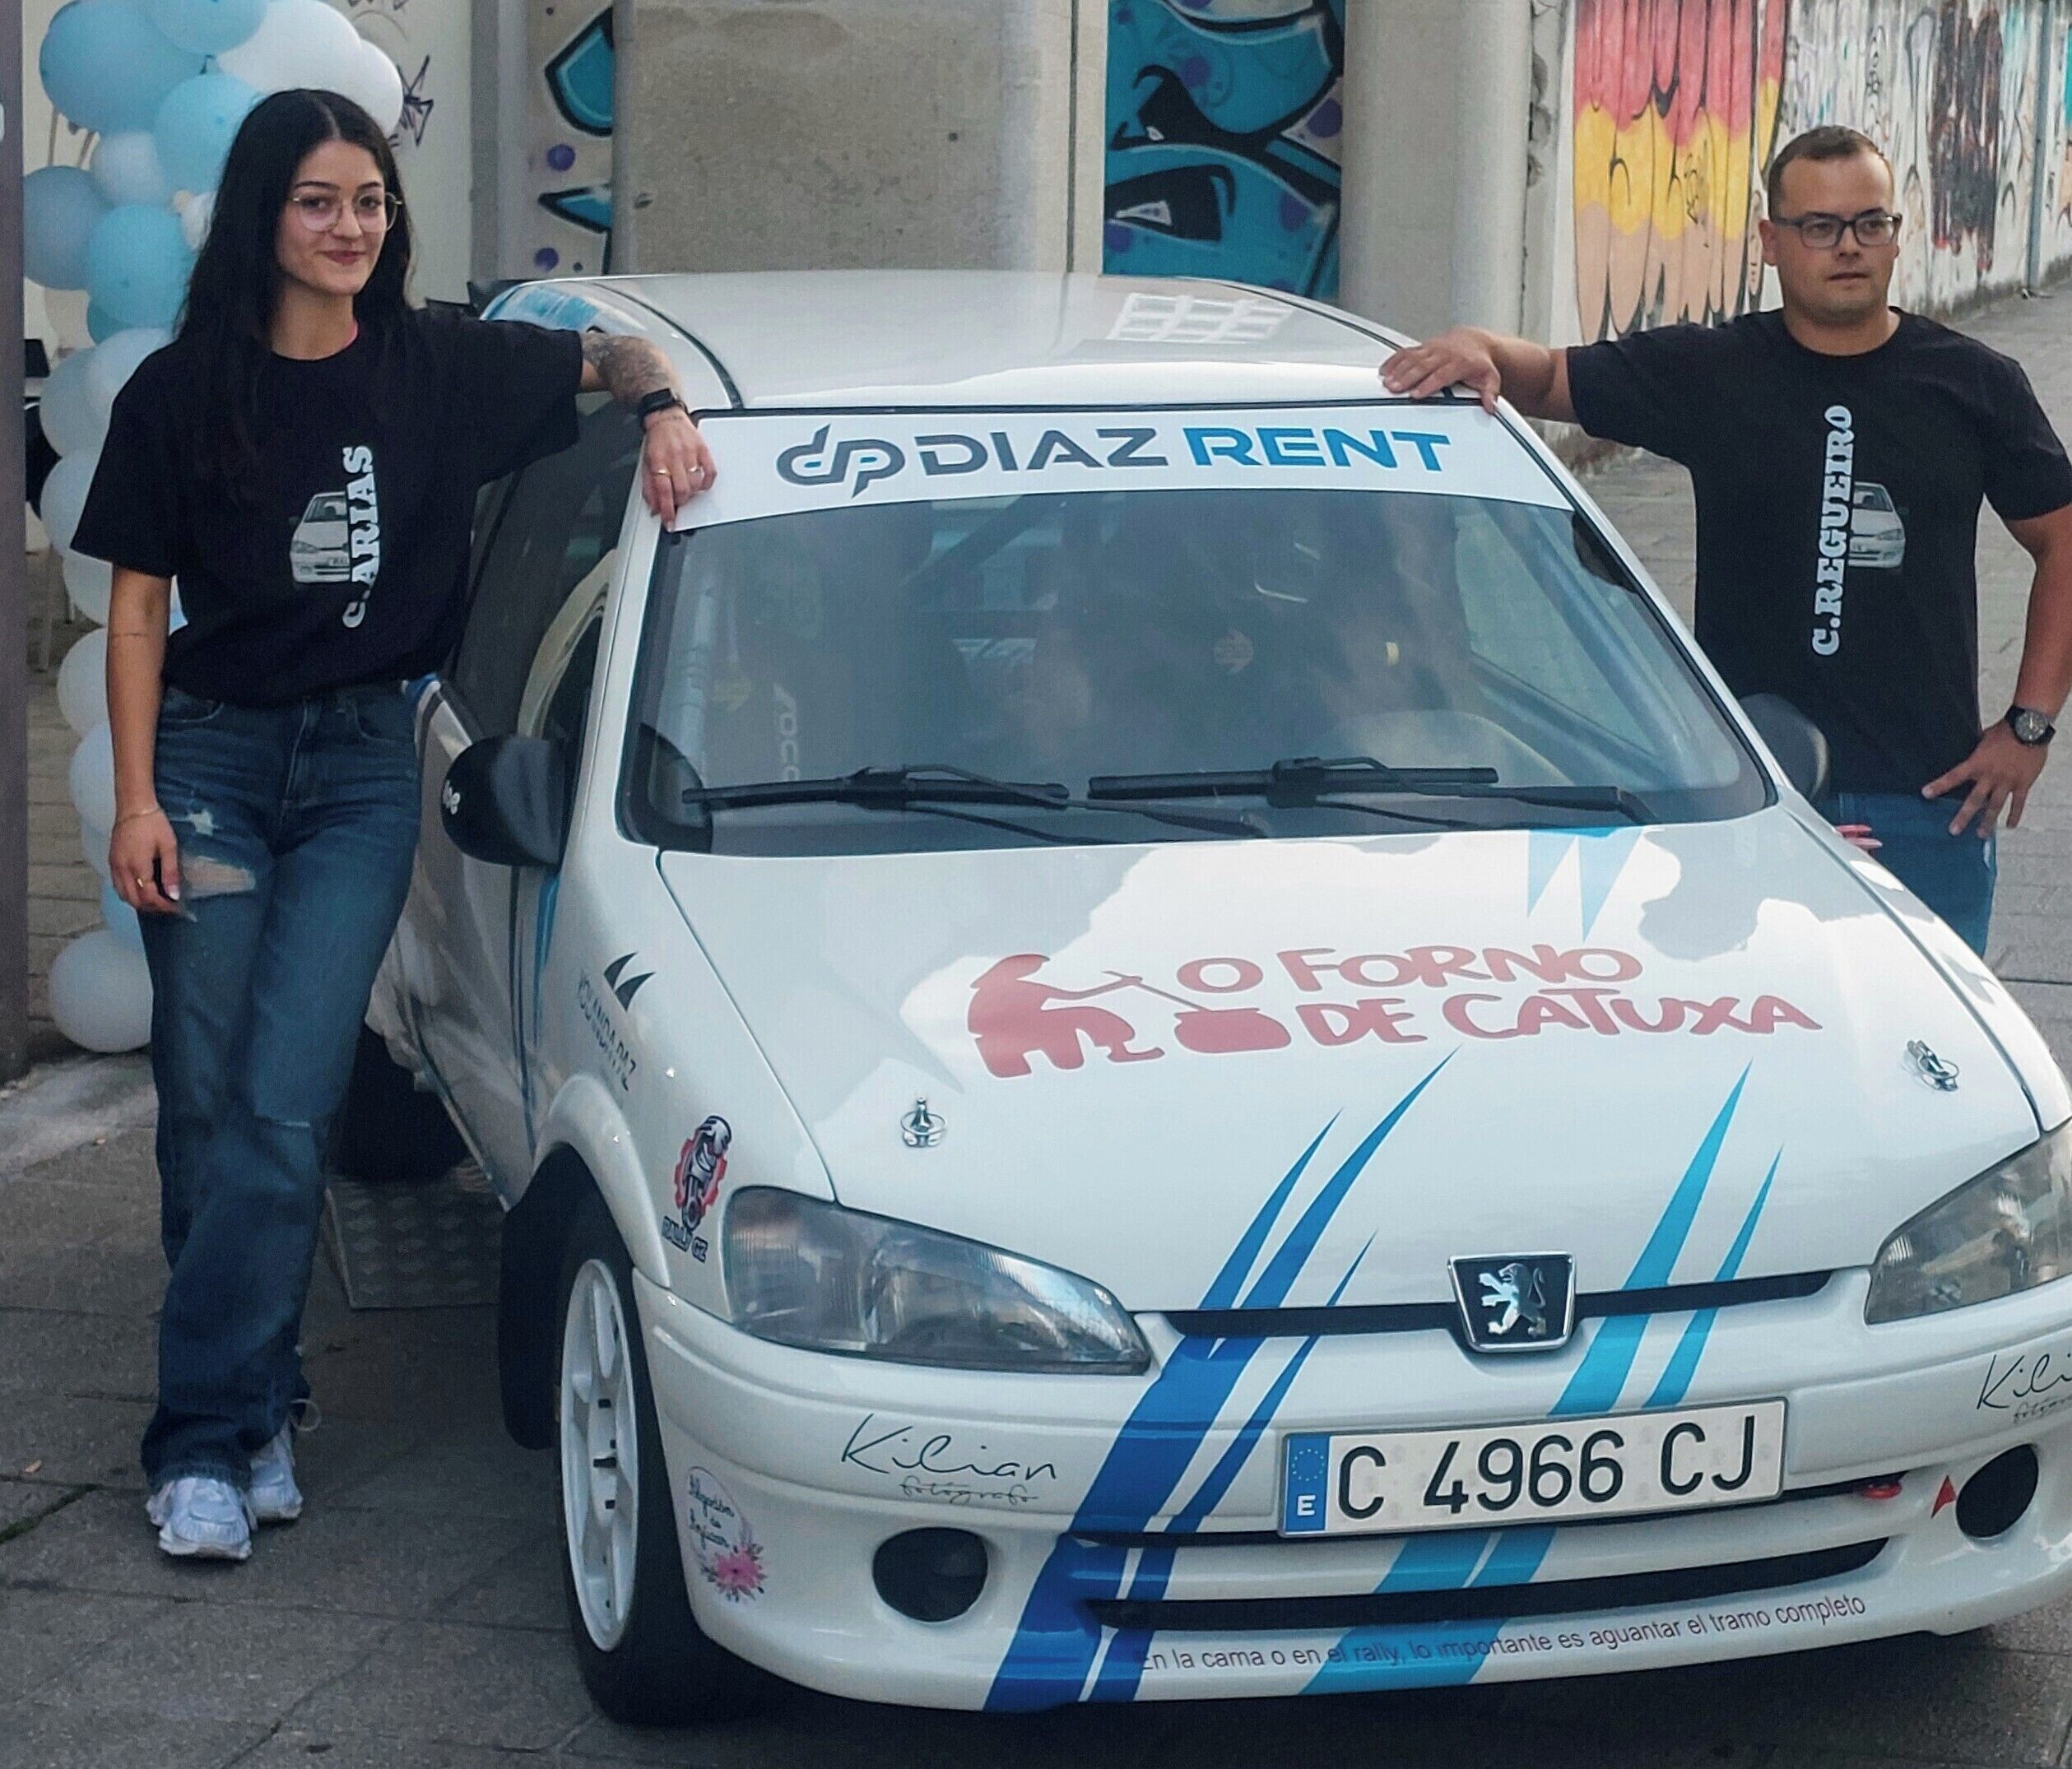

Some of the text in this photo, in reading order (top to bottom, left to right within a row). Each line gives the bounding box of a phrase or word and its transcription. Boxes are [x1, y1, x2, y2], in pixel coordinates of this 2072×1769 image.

[914, 427, 1169, 476] DIAZ
[1182, 427, 1451, 471] RENT
[1812, 405, 1854, 656] C.REGUEIRO
[1177, 944, 1643, 993] O FORNO
[1295, 987, 1823, 1046] DE CATUXA
[841, 1413, 1057, 1481] Kilian
[1297, 1414, 1756, 1519] E C 4966 CJ
[1172, 1648, 1195, 1669] la
[1201, 1648, 1265, 1668] cama
[1271, 1649, 1286, 1665] o
[1292, 1647, 1322, 1665] en
[1327, 1646, 1345, 1663] el
[1409, 1640, 1430, 1659] lo
[1435, 1633, 1553, 1660] importante
[1558, 1632, 1585, 1649] es
[1589, 1619, 1682, 1651] aguantar
[1689, 1614, 1707, 1635] el
[1709, 1609, 1771, 1632] tramo
[1775, 1593, 1865, 1626] completo
